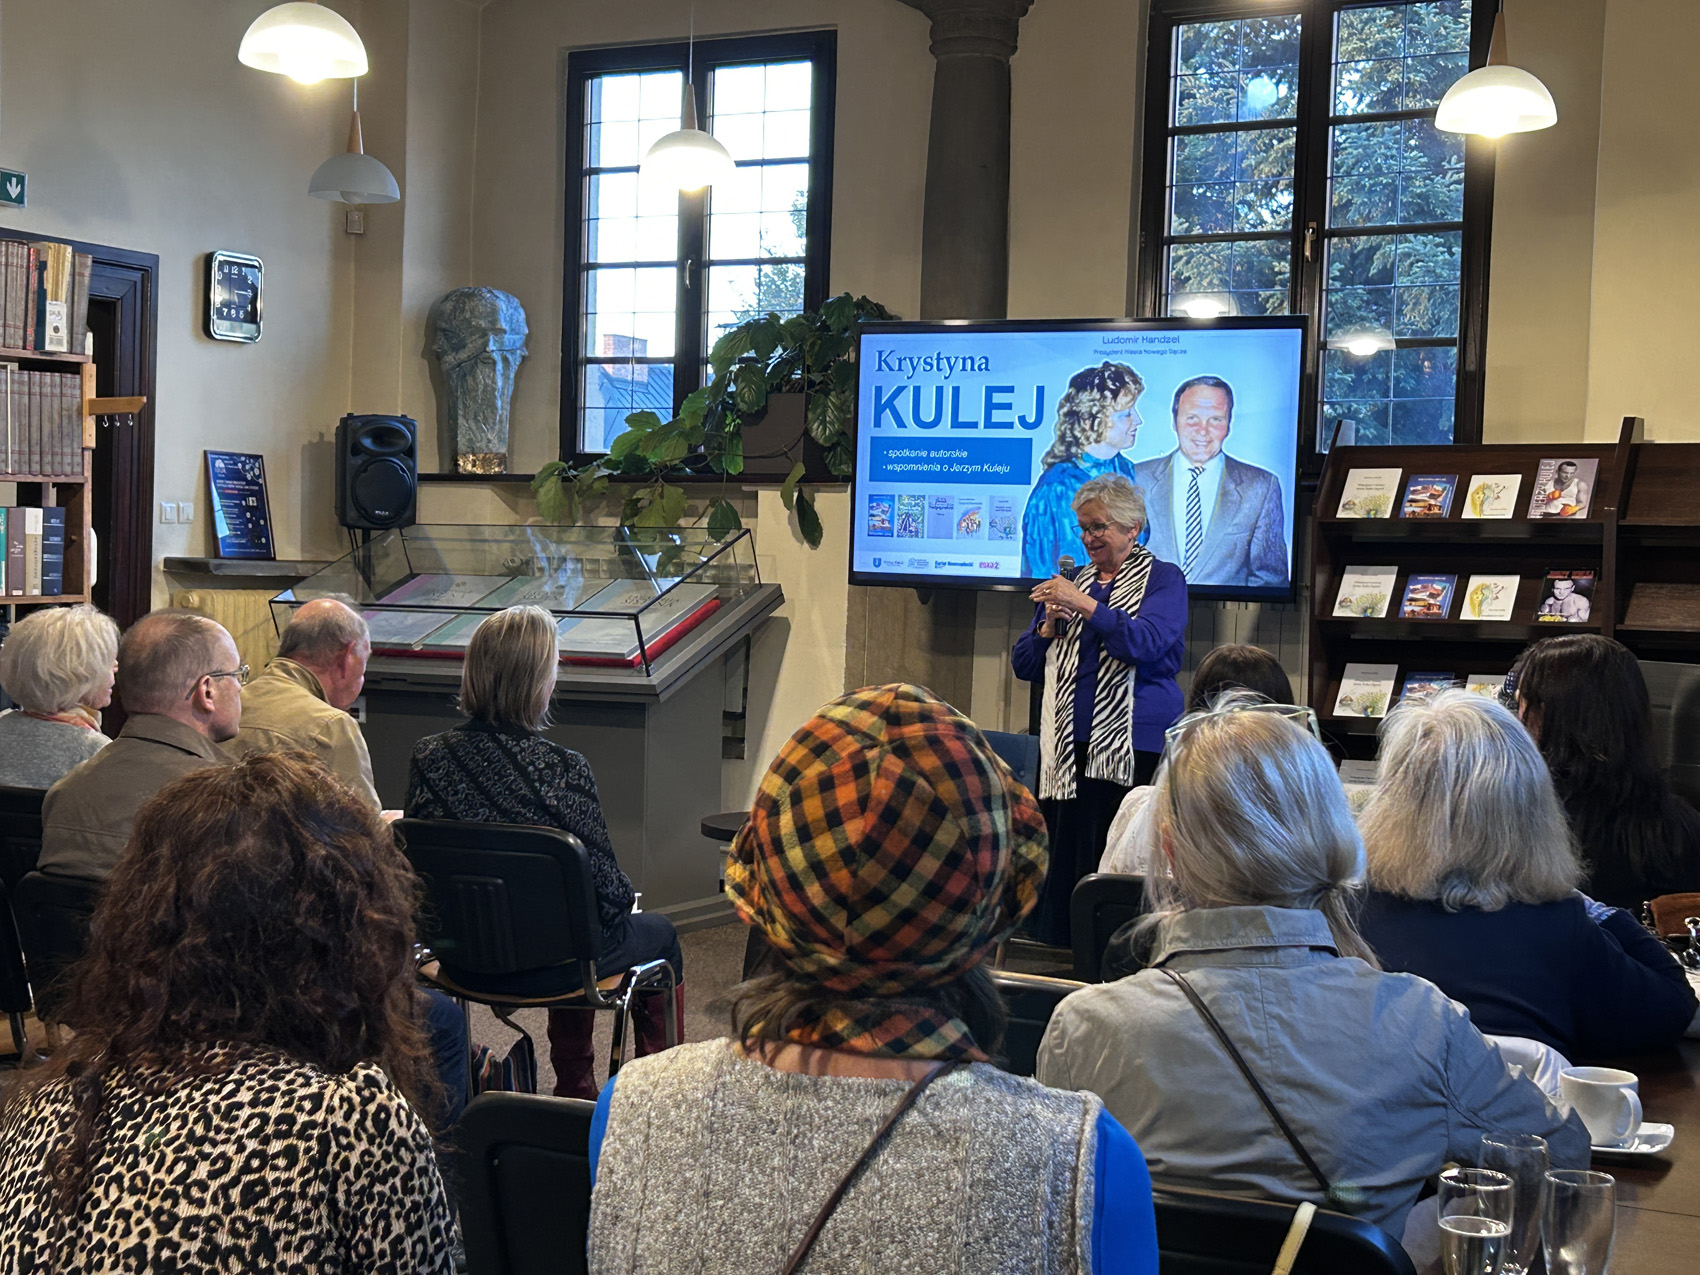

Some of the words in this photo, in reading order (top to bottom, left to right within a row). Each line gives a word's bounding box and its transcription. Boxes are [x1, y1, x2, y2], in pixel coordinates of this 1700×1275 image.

[231, 265, 239, 274] 12
[247, 275, 252, 284] 2
[222, 307, 228, 316] 7
[1102, 335, 1140, 345] Ludomir
[1141, 335, 1180, 344] Handzel
[874, 349, 990, 380] Krystyna
[873, 385, 1045, 430] KULEJ
[888, 448, 928, 459] spotkanie
[929, 448, 968, 459] autorskie
[886, 462, 941, 473] wspomnienia
[950, 462, 981, 474] Jerzym
[982, 463, 1010, 474] Kuleju
